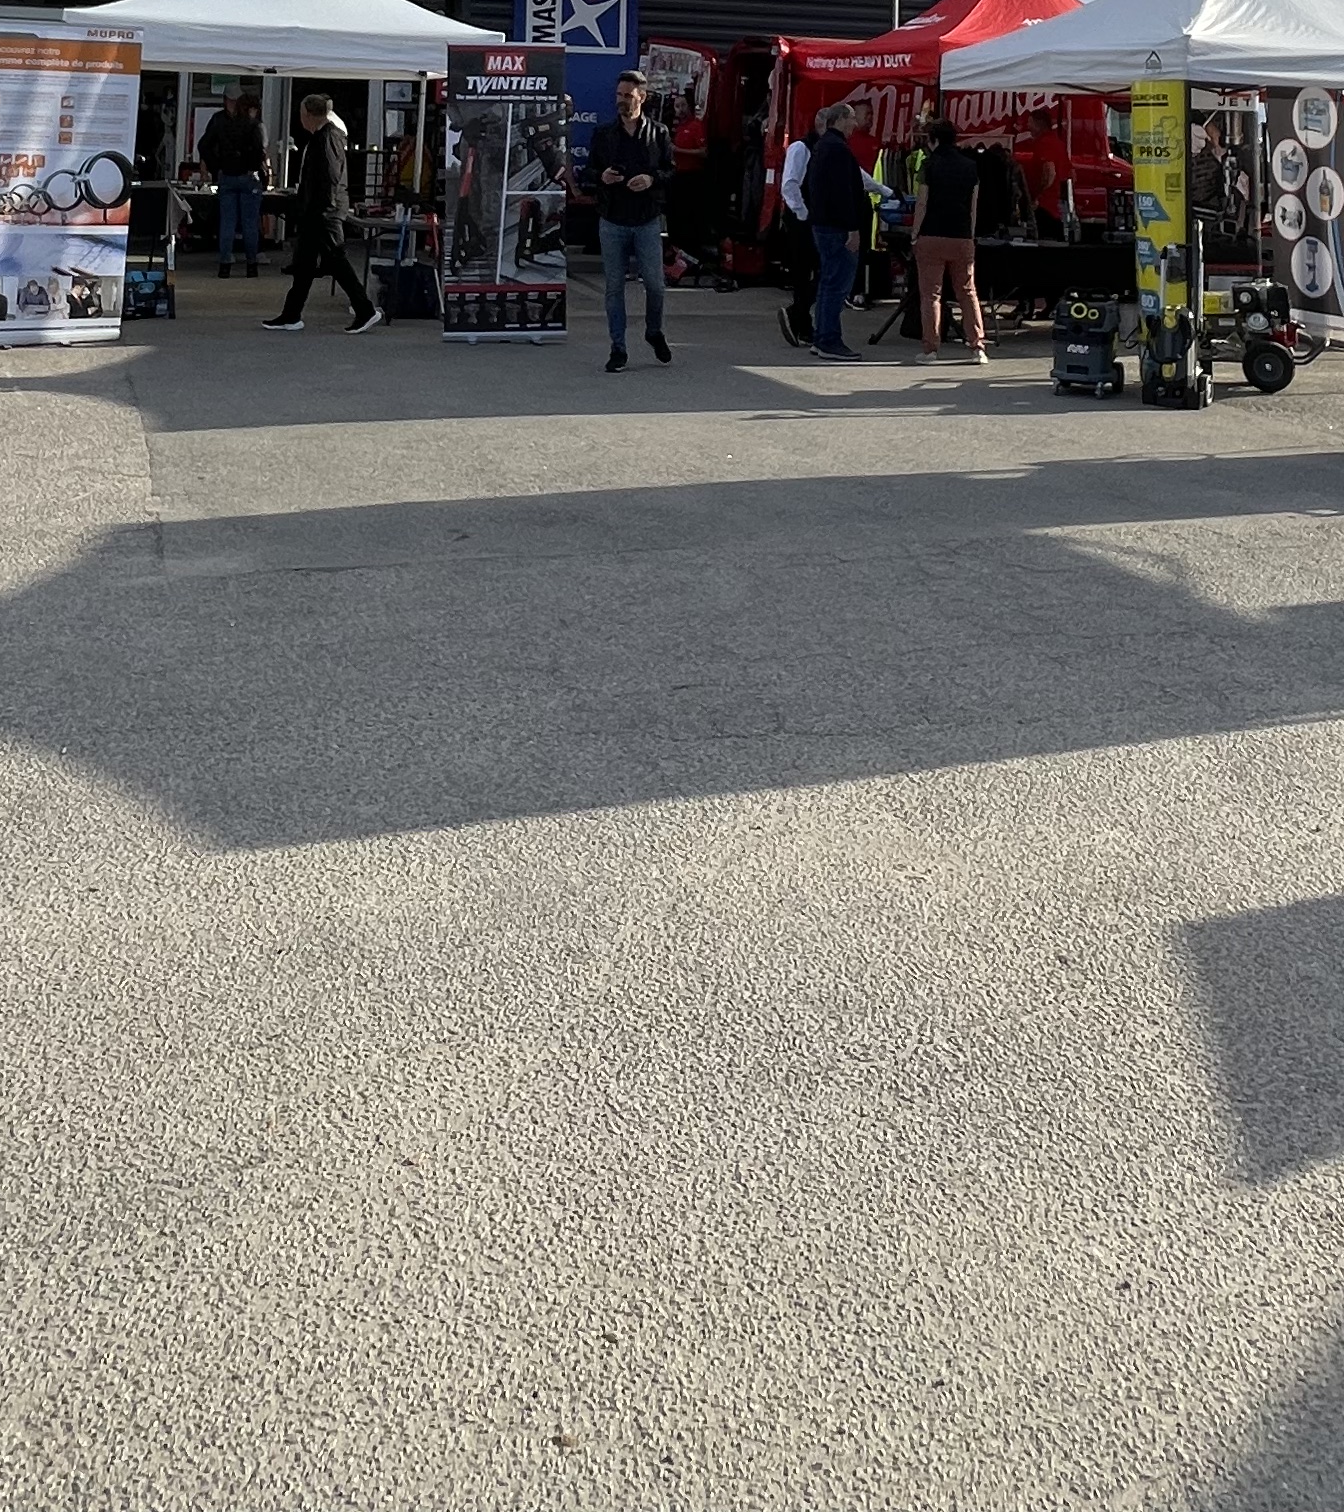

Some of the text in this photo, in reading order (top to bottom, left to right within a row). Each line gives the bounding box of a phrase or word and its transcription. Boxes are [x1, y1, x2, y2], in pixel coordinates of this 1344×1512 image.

[487, 55, 525, 71] MAX
[851, 55, 882, 68] HEAVY
[883, 53, 912, 68] DUTY
[1218, 97, 1251, 107] JET
[1139, 146, 1171, 157] PROS
